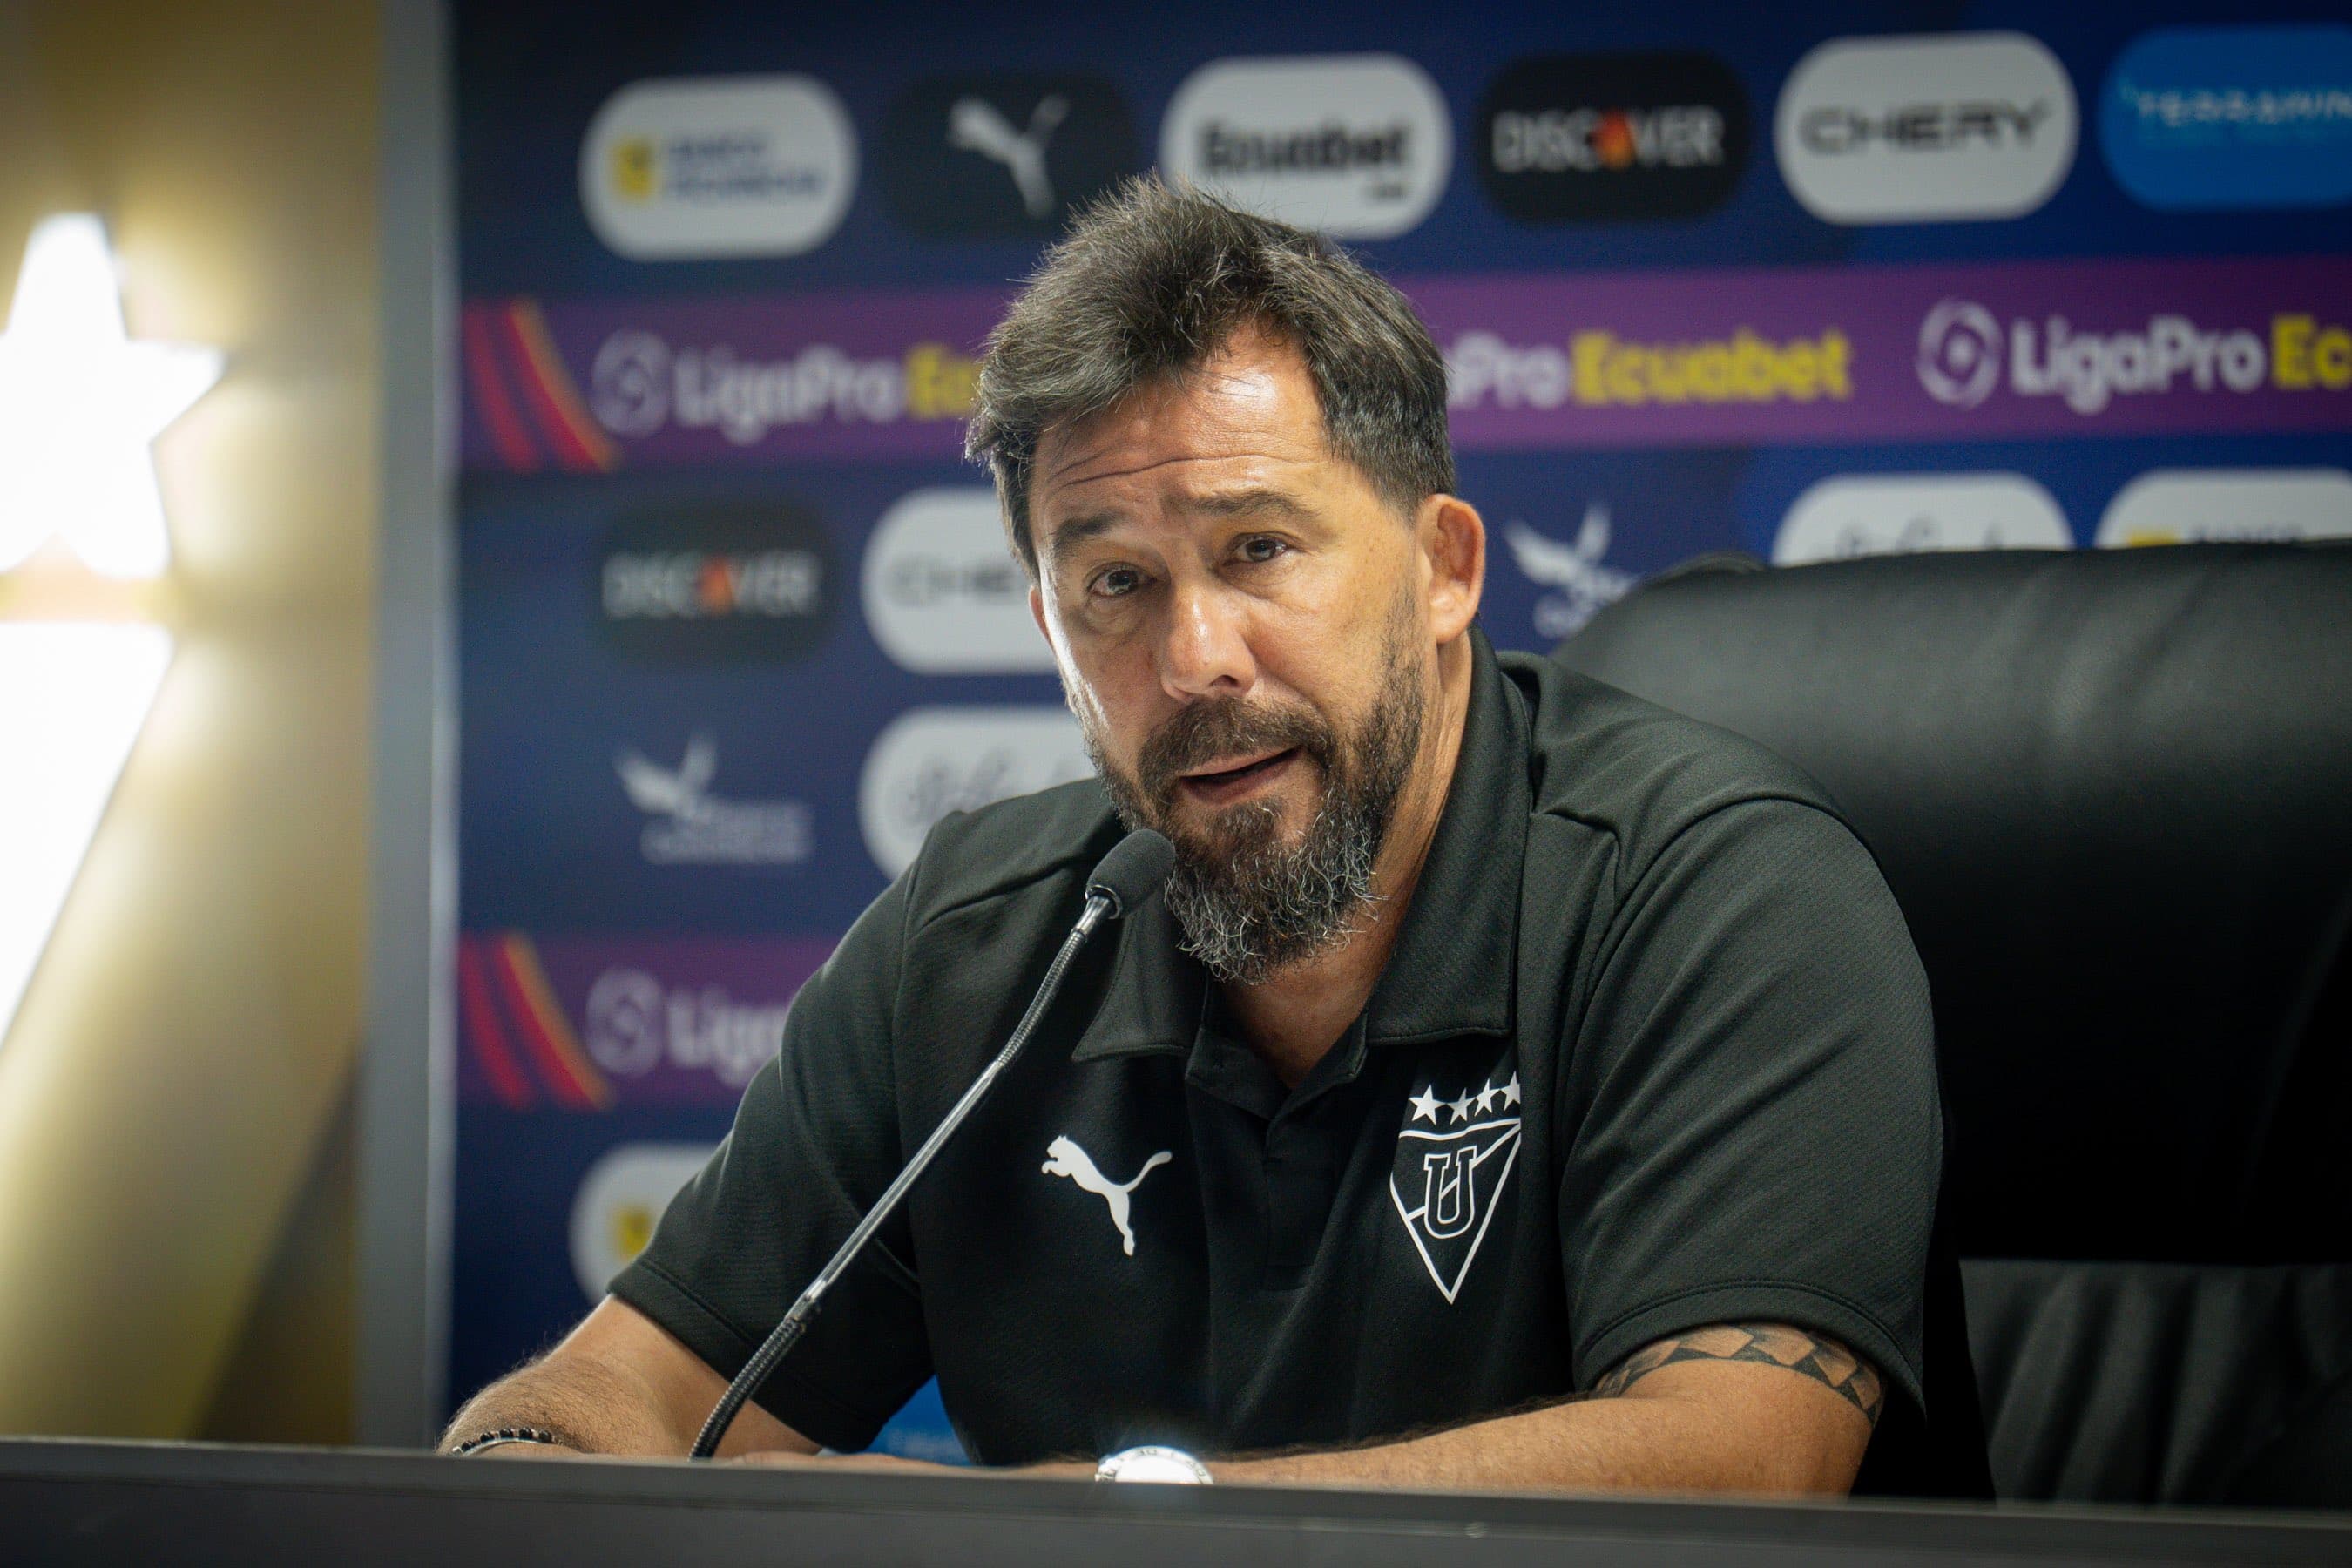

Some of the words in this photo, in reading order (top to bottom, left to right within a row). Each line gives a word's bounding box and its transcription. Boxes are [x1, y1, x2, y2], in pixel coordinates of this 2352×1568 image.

[1492, 106, 1724, 171] DISCOVER
[1798, 98, 2052, 155] CHERY
[673, 343, 903, 443] LigaPro
[1571, 323, 1853, 406] Ecuabet
[2007, 312, 2265, 416] LigaPro
